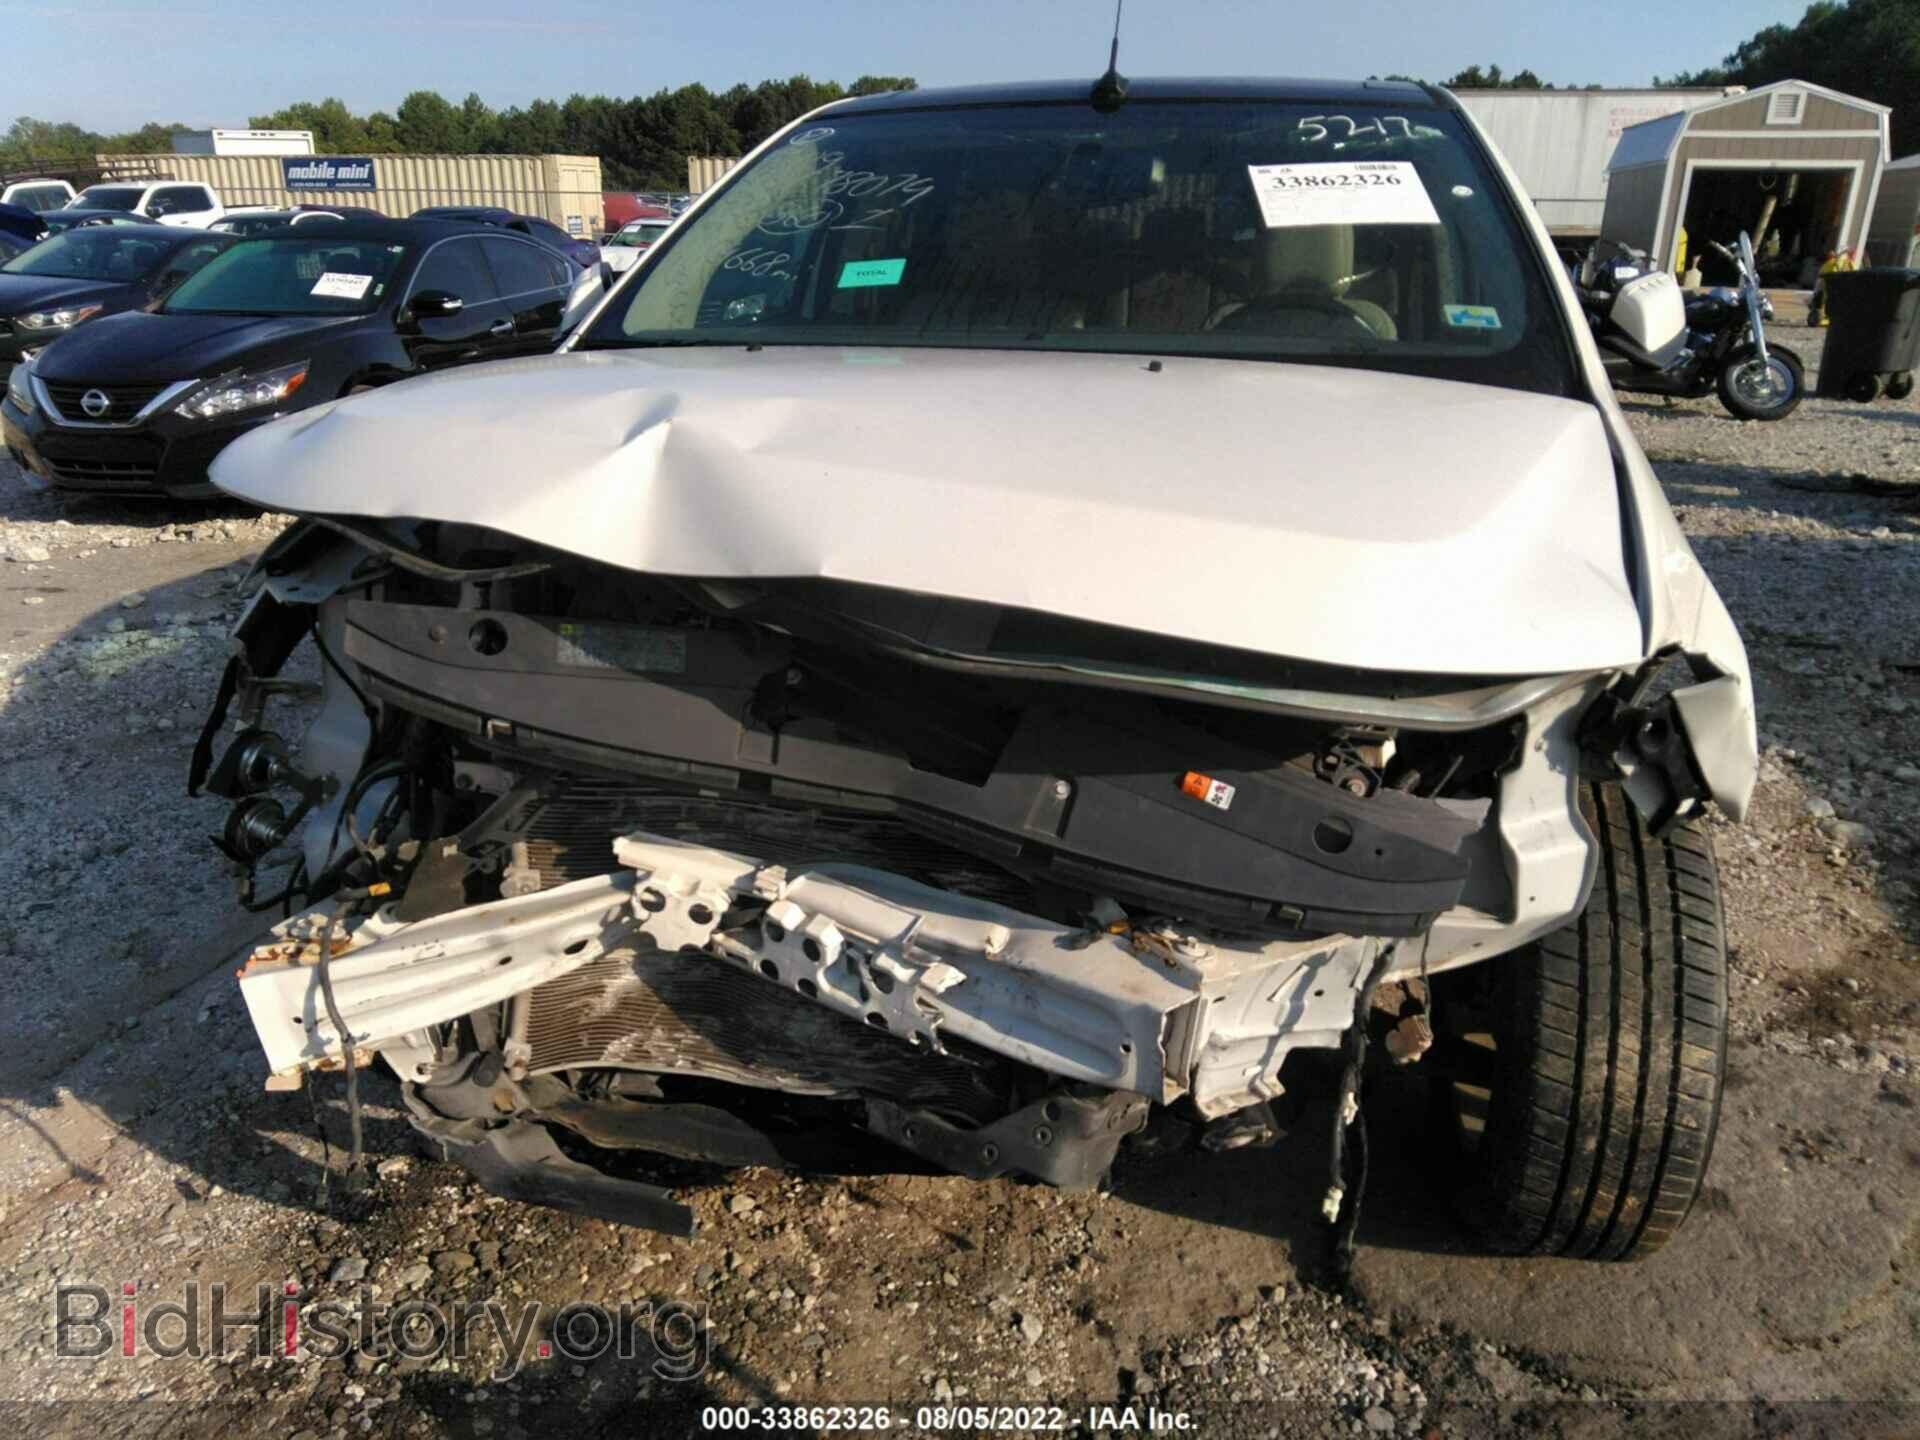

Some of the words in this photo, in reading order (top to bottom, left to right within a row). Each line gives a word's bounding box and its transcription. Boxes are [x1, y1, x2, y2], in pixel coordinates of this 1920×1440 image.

[287, 161, 336, 180] mobile
[337, 163, 372, 180] mini
[1271, 173, 1404, 190] 33862326
